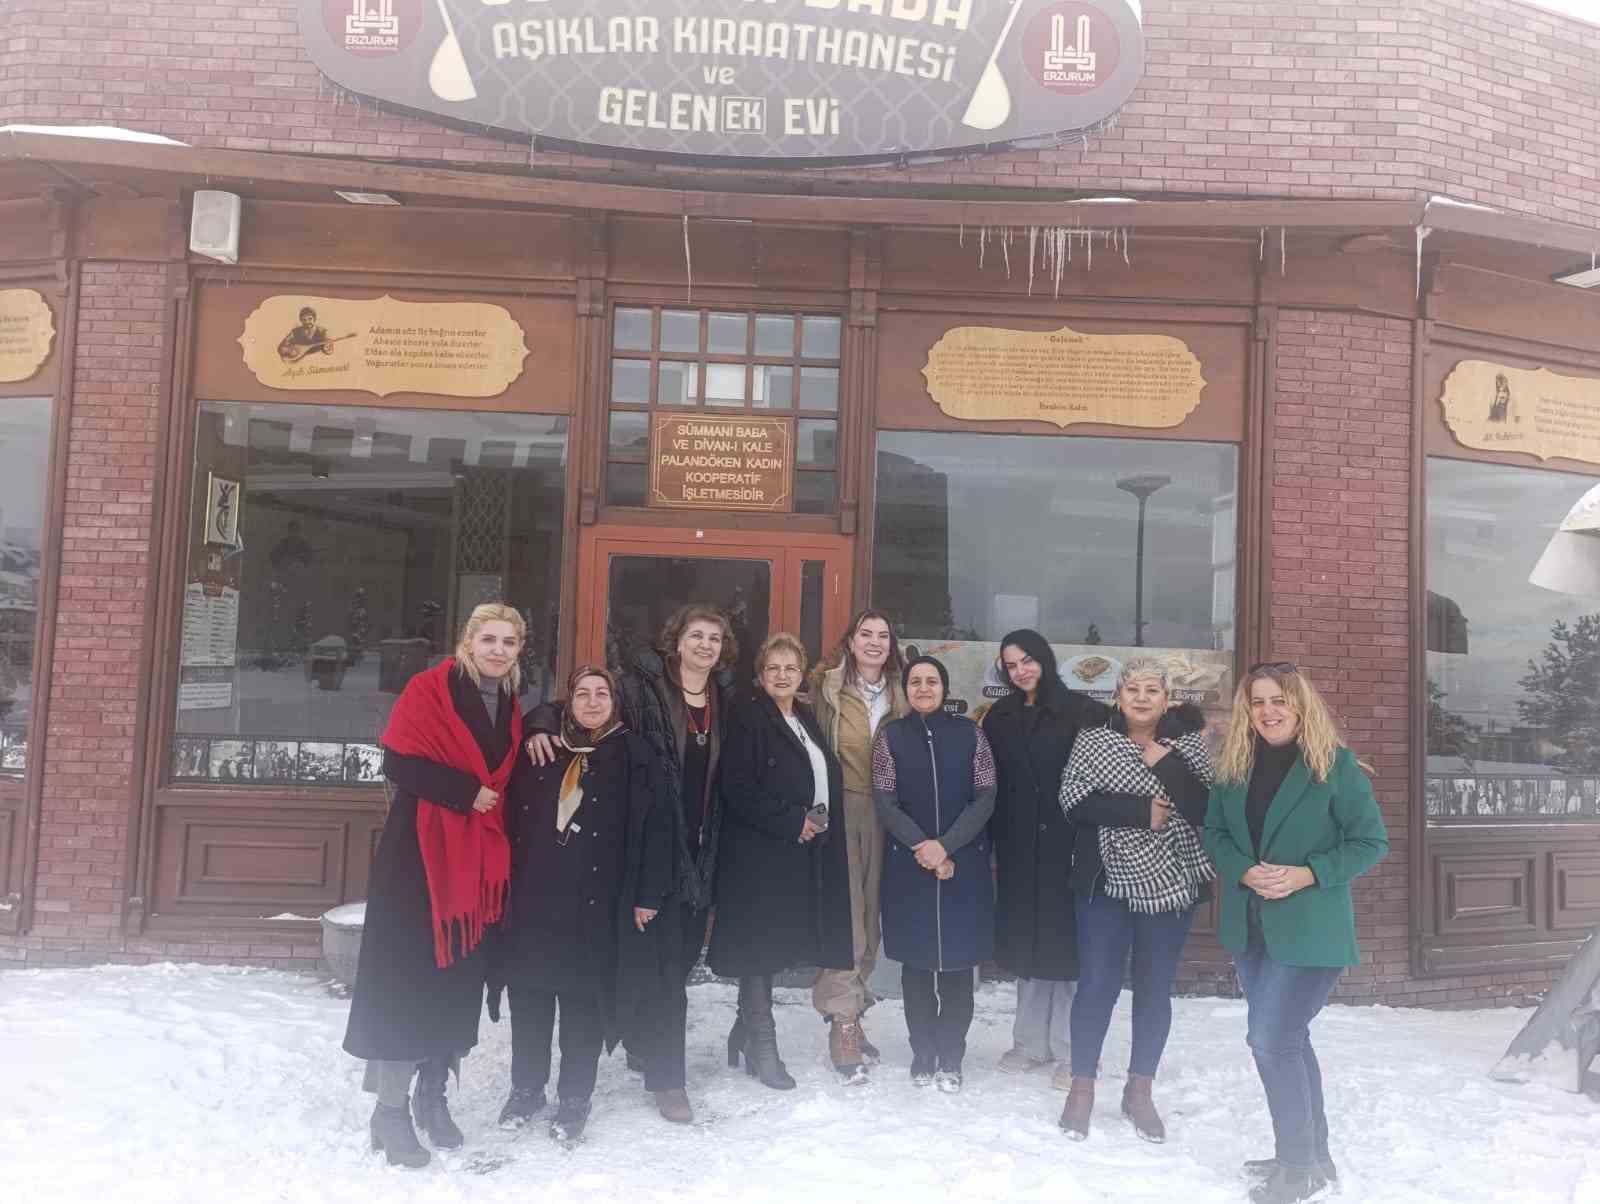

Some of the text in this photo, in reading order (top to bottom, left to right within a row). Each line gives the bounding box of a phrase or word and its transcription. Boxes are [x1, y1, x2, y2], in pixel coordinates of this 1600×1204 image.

[345, 34, 399, 46] ERZURUM
[492, 16, 957, 82] AŞIKLAR KIRAATHANESİ
[703, 64, 736, 85] ve
[1043, 71, 1096, 82] ERZURUM
[677, 423, 768, 438] SÜMMANİ BABA
[672, 438, 773, 453] VE DİVAN-I KALE
[661, 454, 783, 470] PALANDÖKEN KADIN
[685, 471, 762, 484] KOOPERATİF
[682, 485, 765, 500] İŞLETMESİDİR
